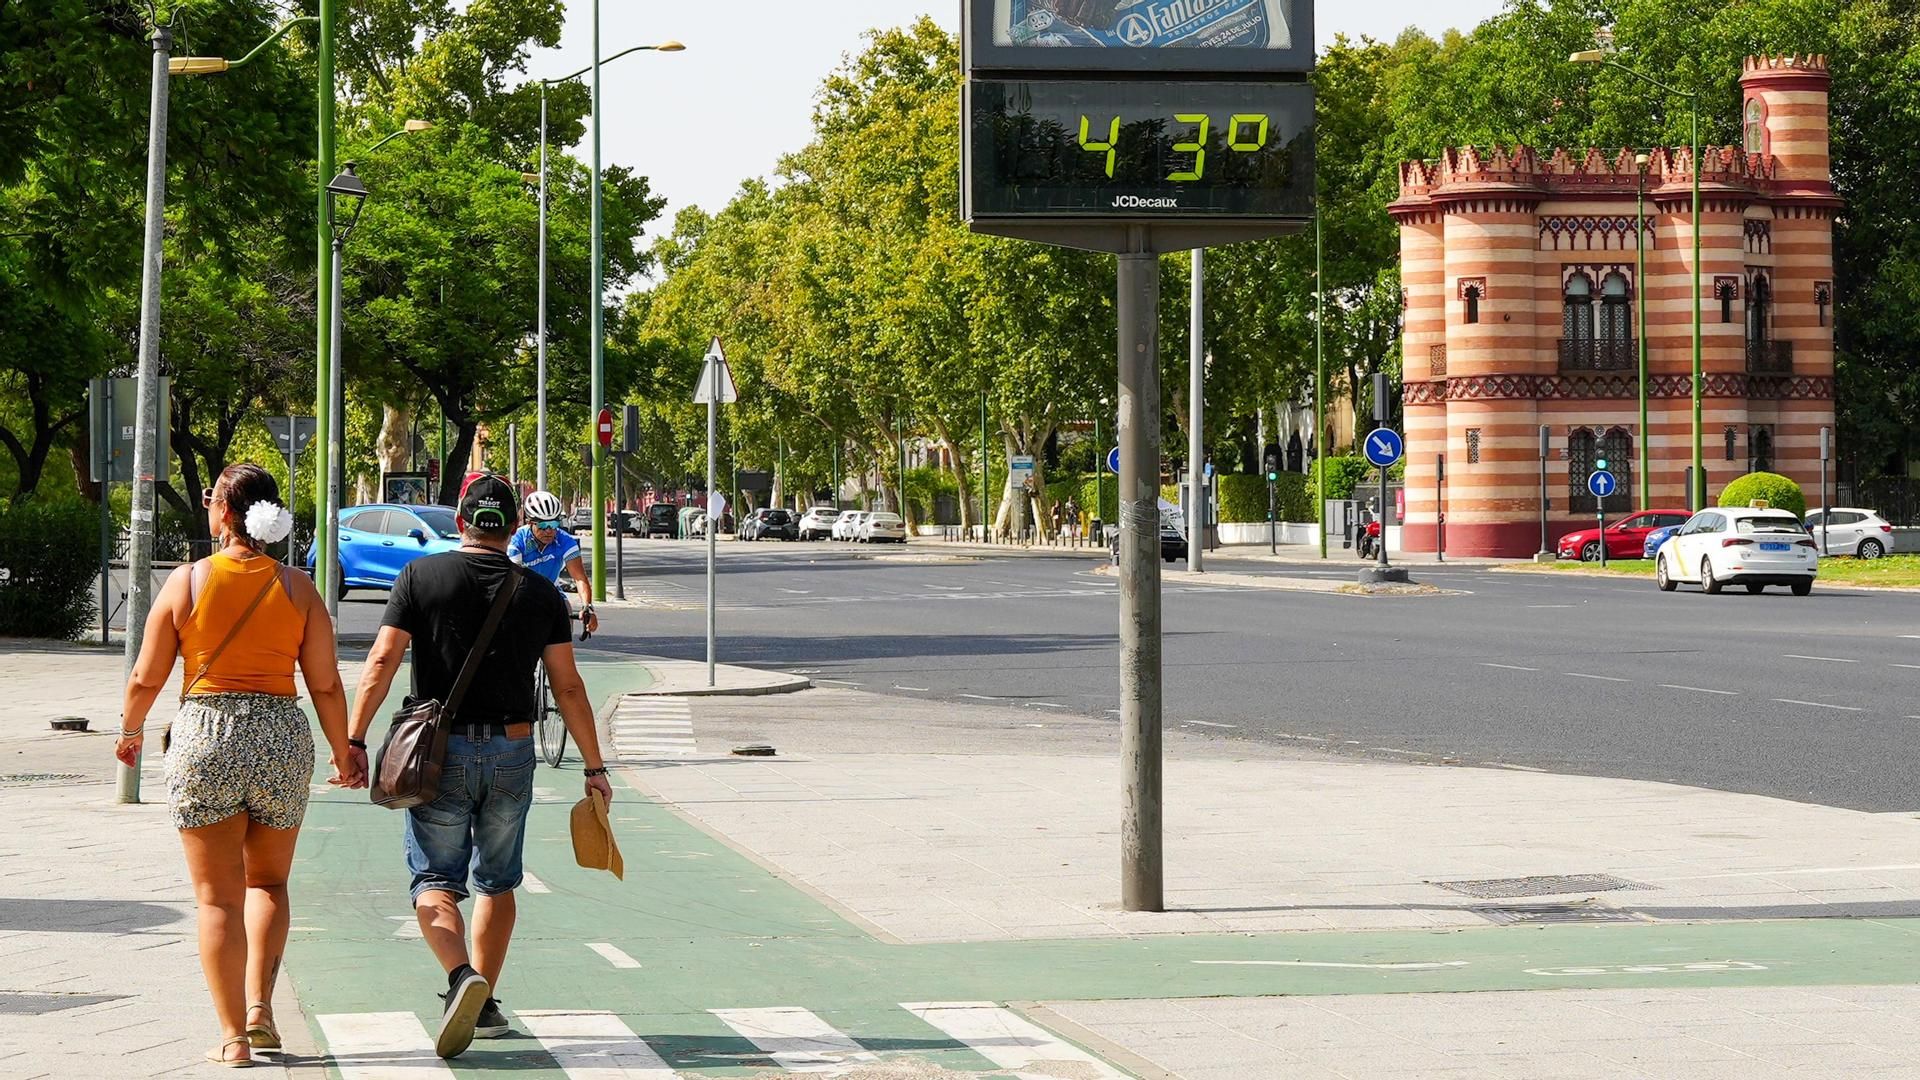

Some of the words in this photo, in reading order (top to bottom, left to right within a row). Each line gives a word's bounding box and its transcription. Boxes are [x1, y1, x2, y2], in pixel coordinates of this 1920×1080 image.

[1168, 9, 1220, 38] PRIMEROS
[1220, 30, 1232, 40] 24
[1230, 25, 1242, 34] DE
[1240, 15, 1262, 30] JULIO
[1111, 195, 1178, 208] JCDecaux
